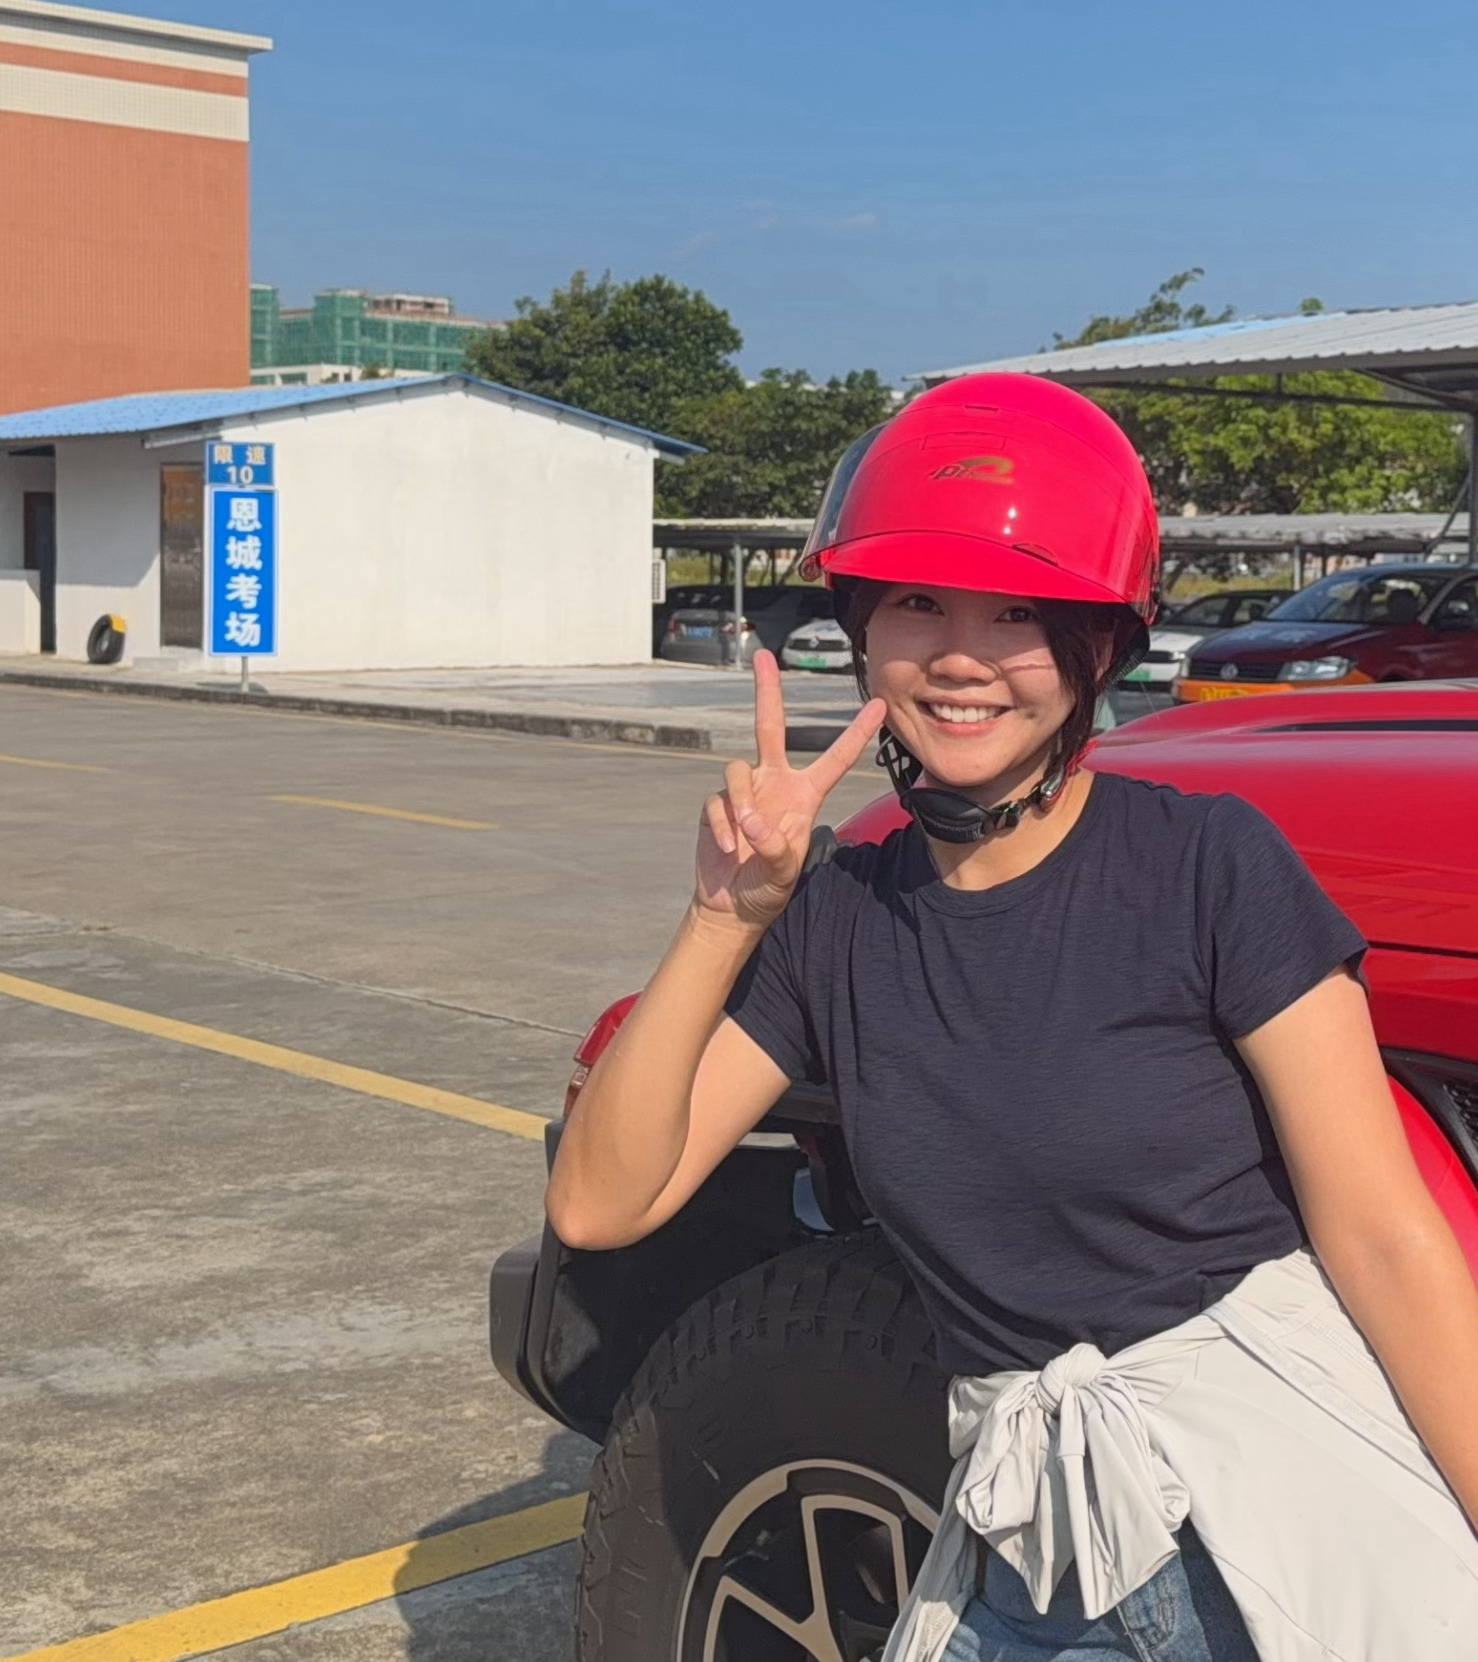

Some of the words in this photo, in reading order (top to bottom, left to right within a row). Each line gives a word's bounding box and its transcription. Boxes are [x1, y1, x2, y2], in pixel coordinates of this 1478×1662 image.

[227, 465, 253, 484] 10
[224, 497, 263, 647] 恩城考场
